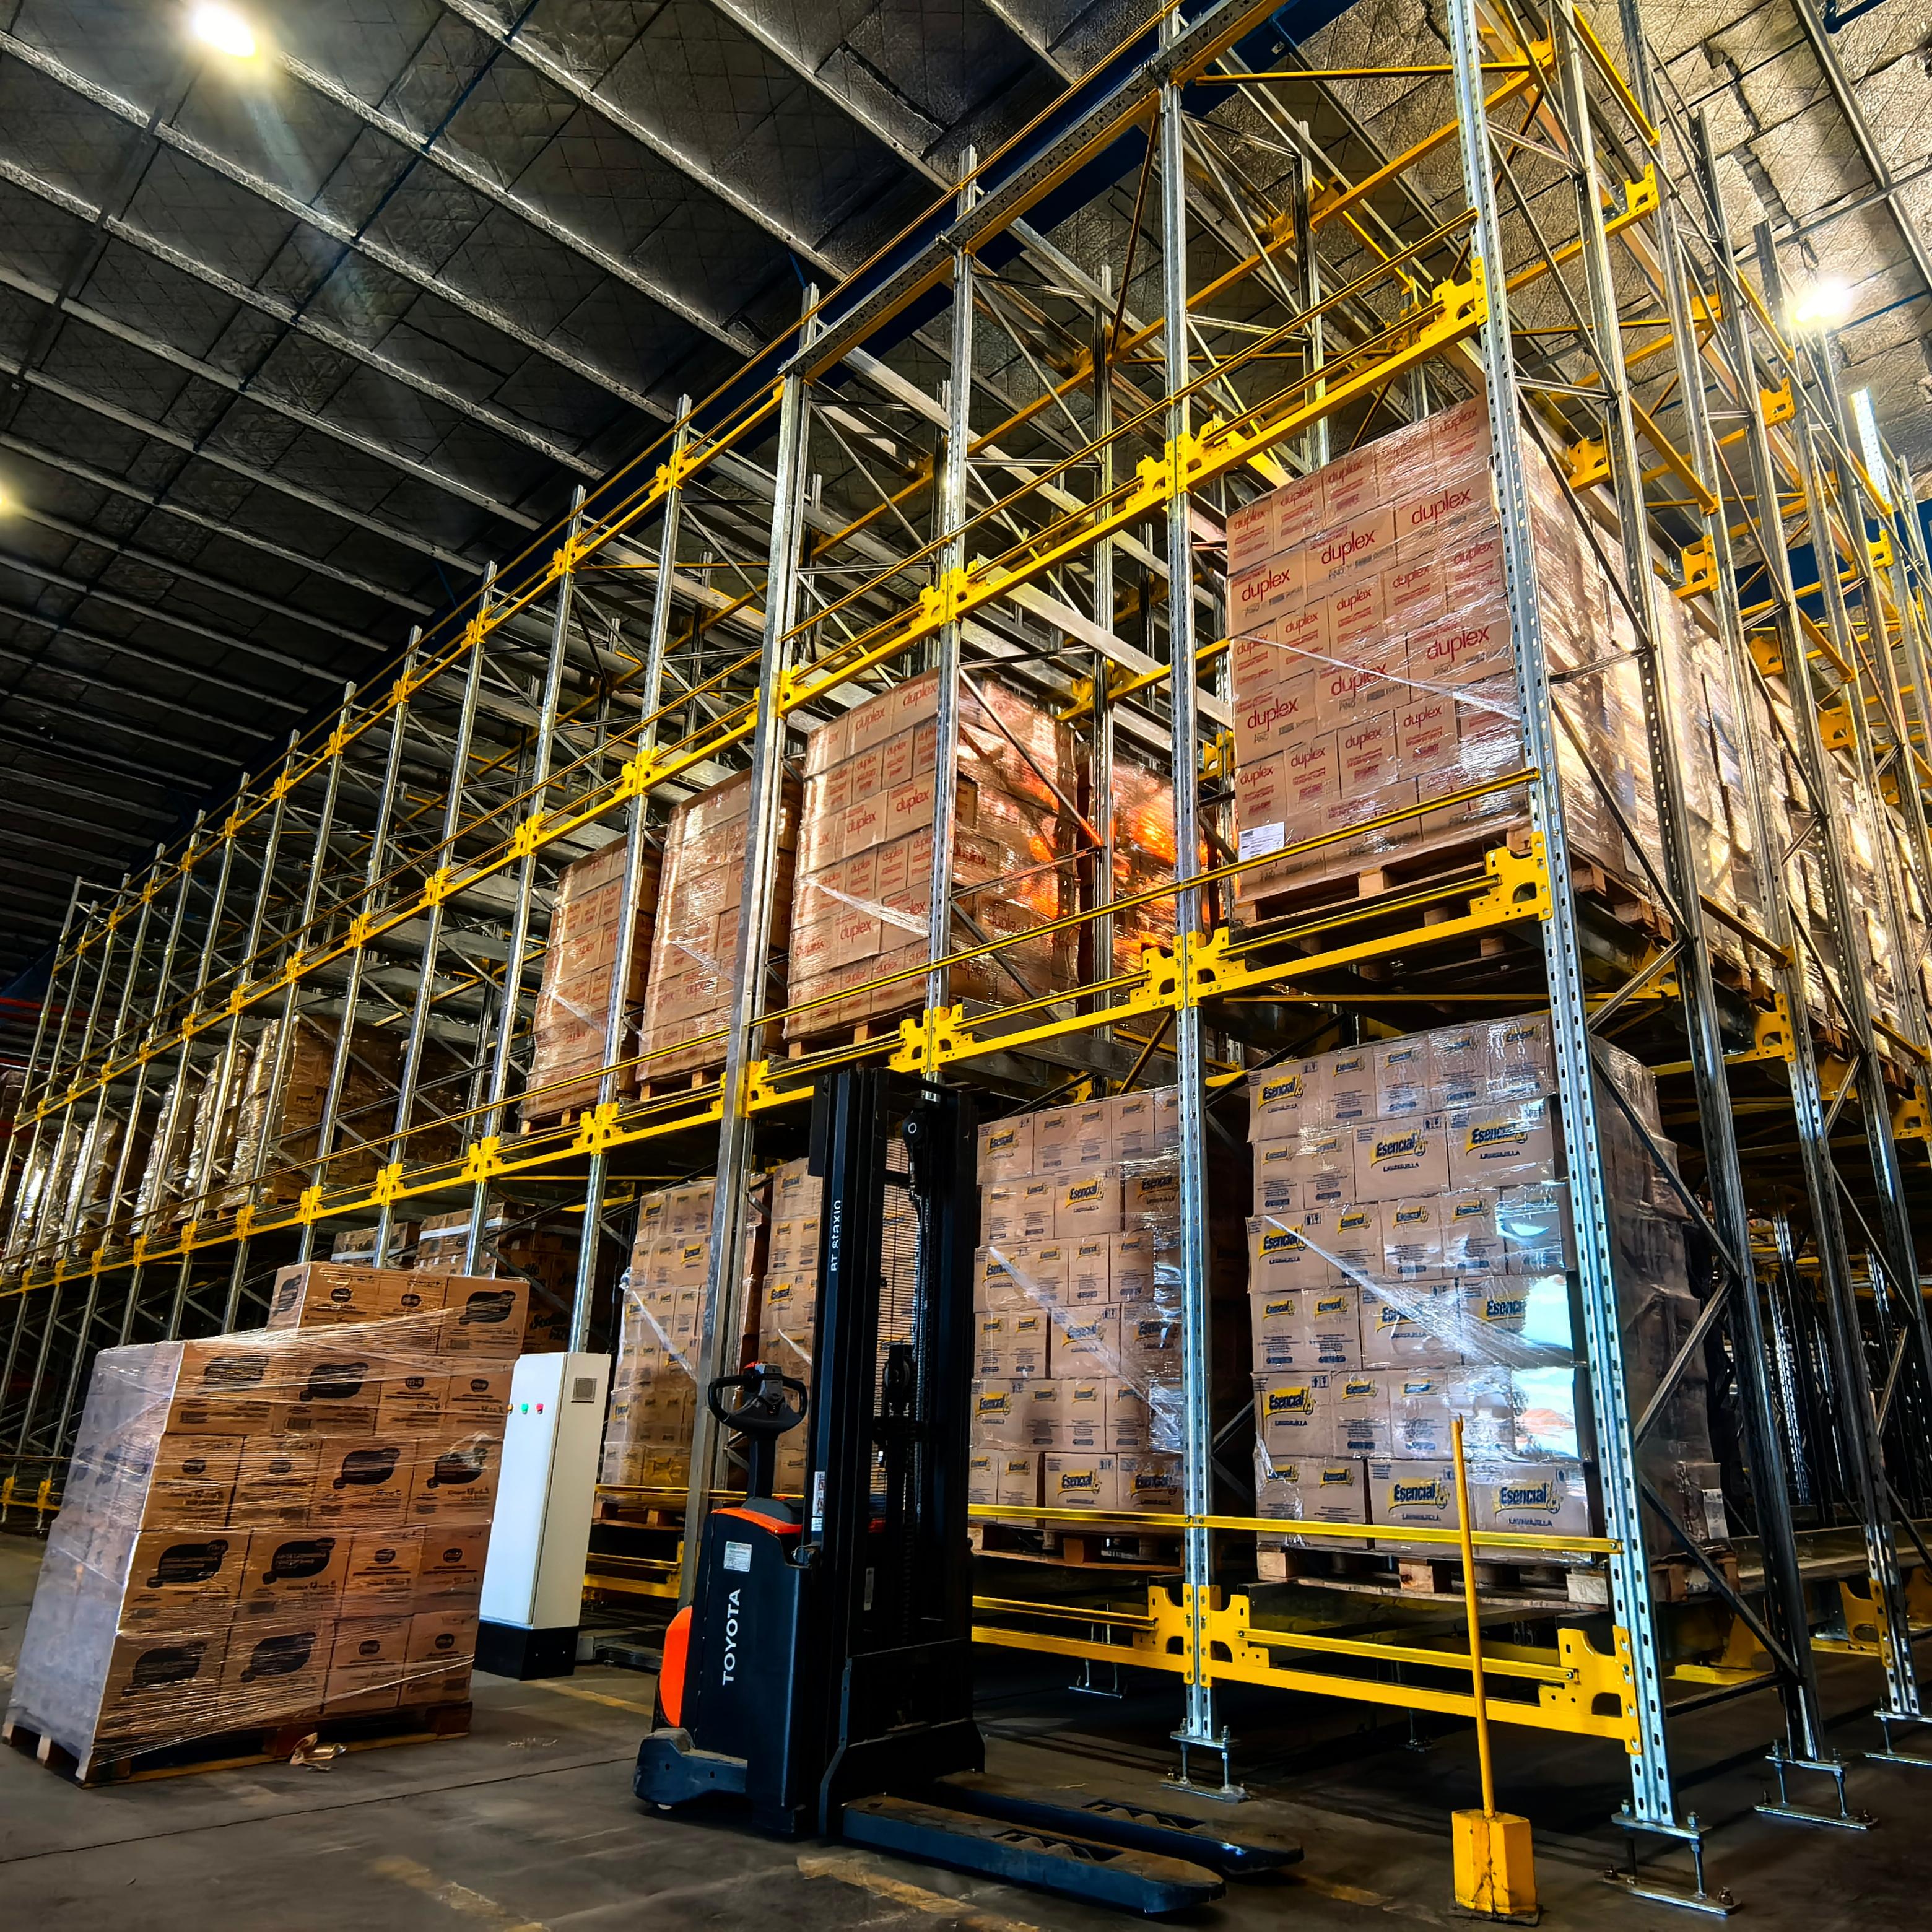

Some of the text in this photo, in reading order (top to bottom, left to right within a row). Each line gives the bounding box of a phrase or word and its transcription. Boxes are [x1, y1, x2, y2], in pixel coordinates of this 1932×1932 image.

[1411, 487, 1472, 525] duplex
[1321, 530, 1375, 565] duplex
[1242, 568, 1290, 602] duplex
[1336, 588, 1372, 611] duplex
[1285, 612, 1318, 634] duplex
[1426, 625, 1490, 662] duplex
[903, 682, 936, 707] duplex
[856, 707, 885, 732] duplex
[1247, 697, 1299, 732] duplex
[1403, 705, 1442, 729] duplex
[1345, 726, 1383, 750] duplex
[1290, 746, 1326, 769] duplex
[1240, 765, 1274, 787] duplex
[896, 790, 929, 816] duplex
[846, 811, 876, 835] duplex
[840, 920, 871, 944] duplex
[1263, 1076, 1295, 1100] Esencial
[1377, 1133, 1416, 1157] Esencial
[1269, 1389, 1304, 1410] Esencial
[1394, 1482, 1435, 1502] Esencial
[1501, 1482, 1547, 1505] Esencial
[722, 1588, 741, 1686] TOYOTA
